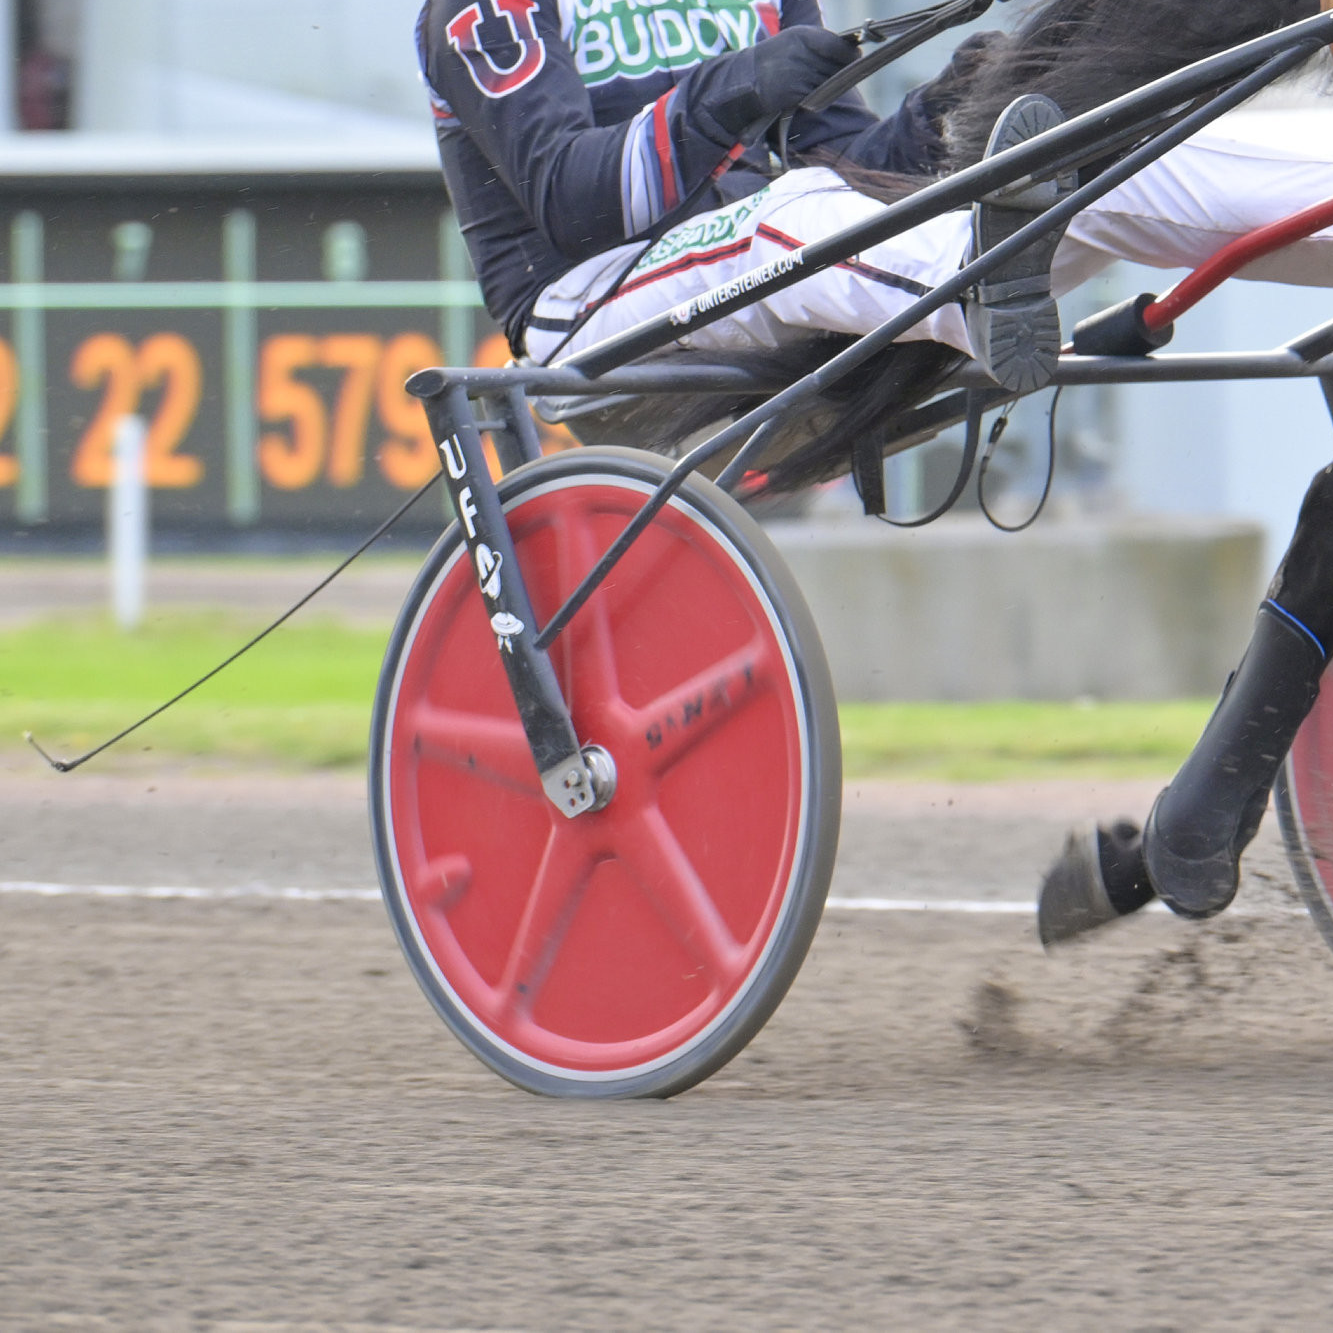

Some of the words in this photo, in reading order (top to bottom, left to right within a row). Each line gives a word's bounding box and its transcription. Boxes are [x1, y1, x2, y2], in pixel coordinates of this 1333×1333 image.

[573, 8, 751, 75] BUDDY
[697, 250, 804, 313] UNTERSTEINER.COM
[70, 332, 204, 488] 22
